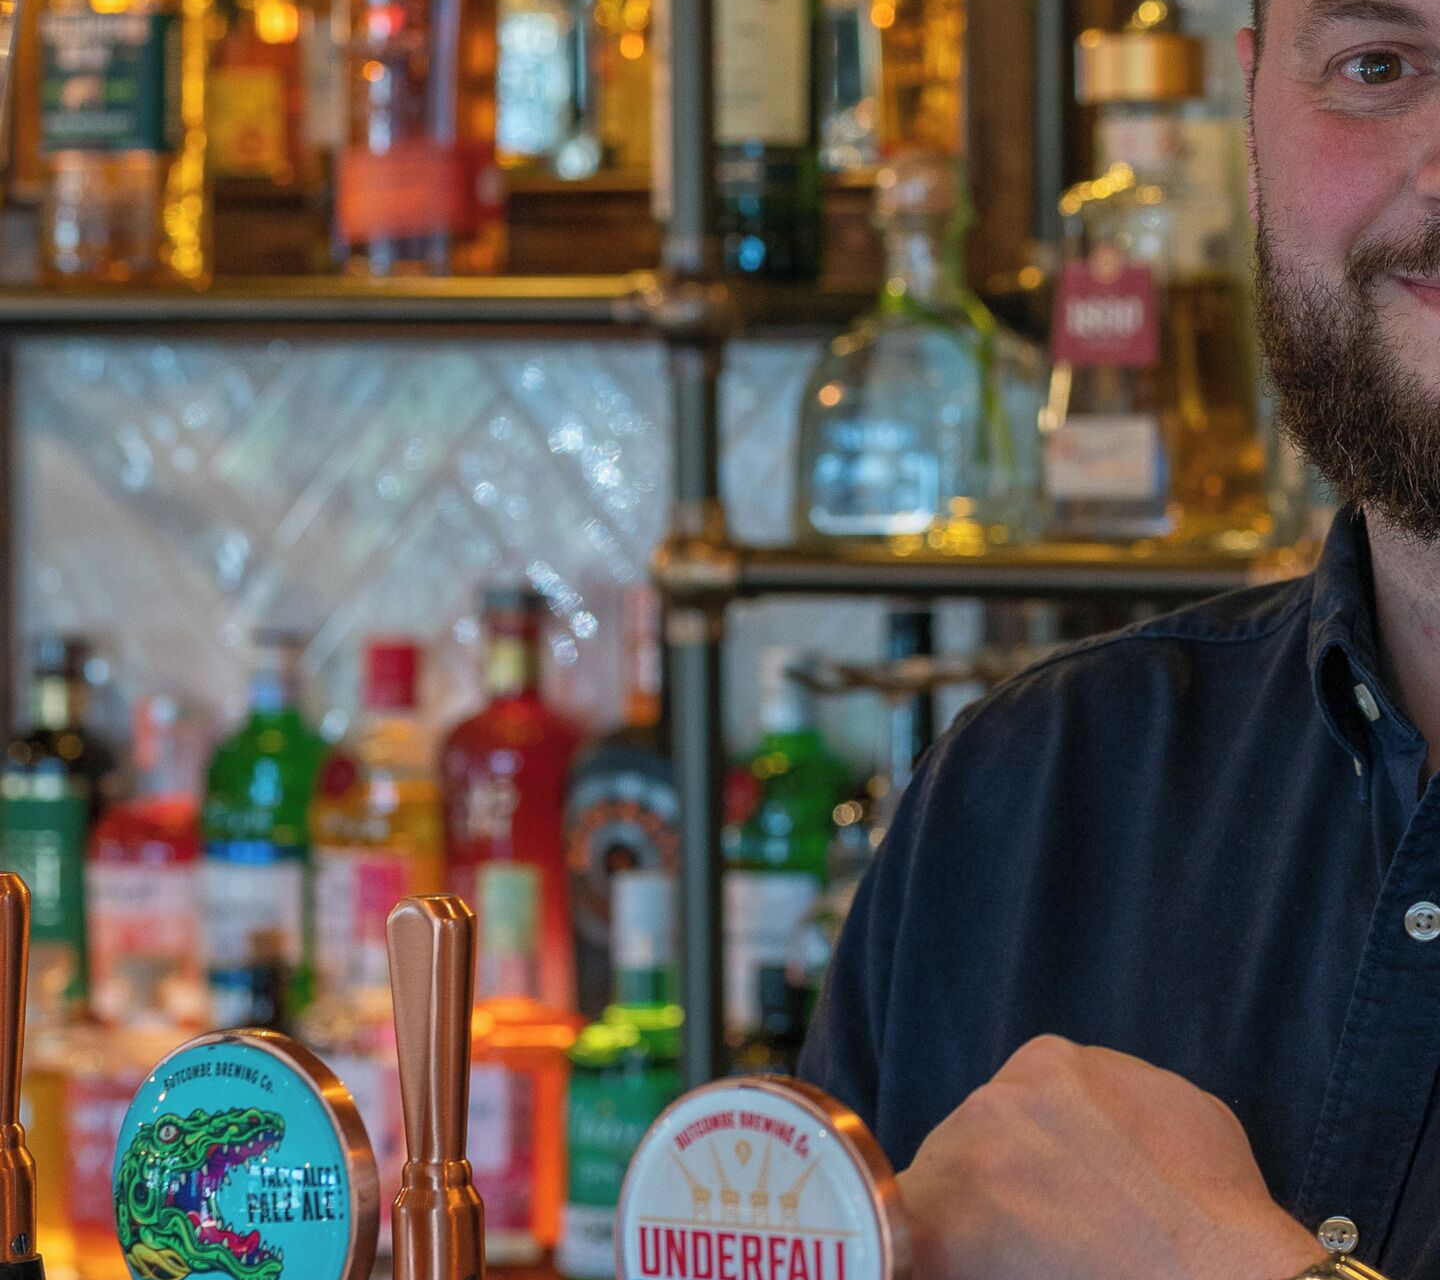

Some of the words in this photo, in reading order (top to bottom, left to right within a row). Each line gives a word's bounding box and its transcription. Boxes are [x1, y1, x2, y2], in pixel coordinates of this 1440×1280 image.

[215, 1061, 260, 1085] BREWING
[673, 1109, 735, 1152] BUTCOMBE
[738, 1109, 797, 1147] BREWING
